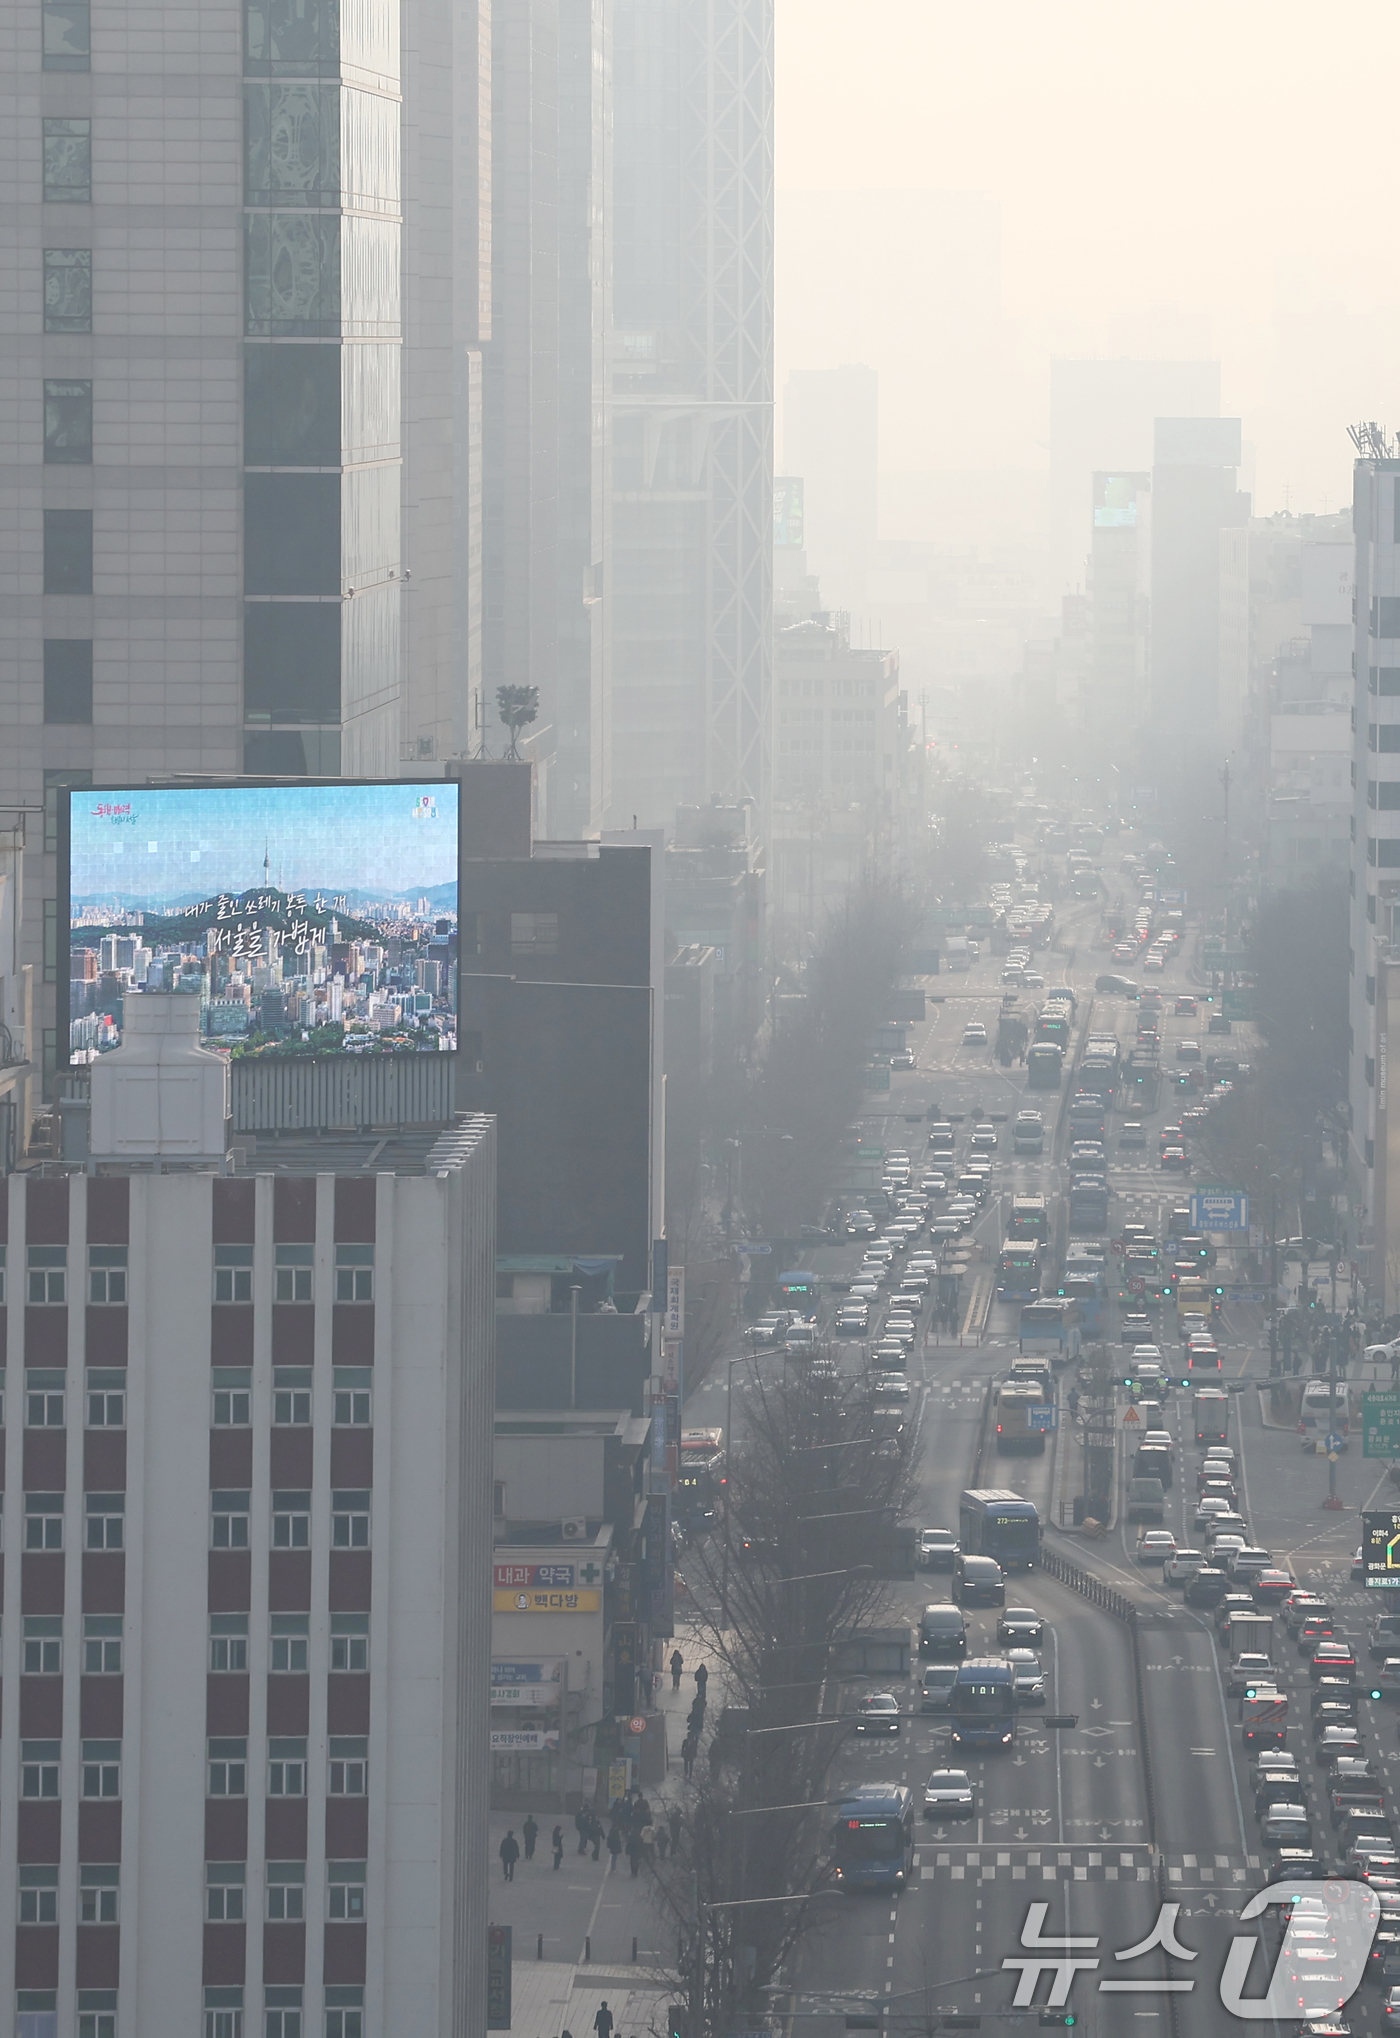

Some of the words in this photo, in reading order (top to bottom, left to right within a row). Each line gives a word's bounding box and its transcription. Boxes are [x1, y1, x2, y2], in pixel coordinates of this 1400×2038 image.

[184, 902, 214, 918] 내가
[216, 895, 239, 920] 줄인
[245, 896, 282, 916] 쓰레기
[285, 893, 308, 918] 봉투
[313, 893, 328, 912] 한
[213, 921, 267, 959] 서울을
[273, 921, 327, 956] 가볍게
[1379, 1054, 1387, 1089] museum
[1132, 1282, 1141, 1290] 50
[669, 1278, 680, 1331] 국제회계학원
[997, 1517, 1008, 1525] 273
[1372, 1529, 1389, 1537] 이화4
[1367, 1562, 1387, 1571] 광화문
[497, 1567, 530, 1585] 내과
[538, 1566, 572, 1585] 약국
[534, 1593, 579, 1609] 빽다방
[971, 1686, 996, 1695] 101
